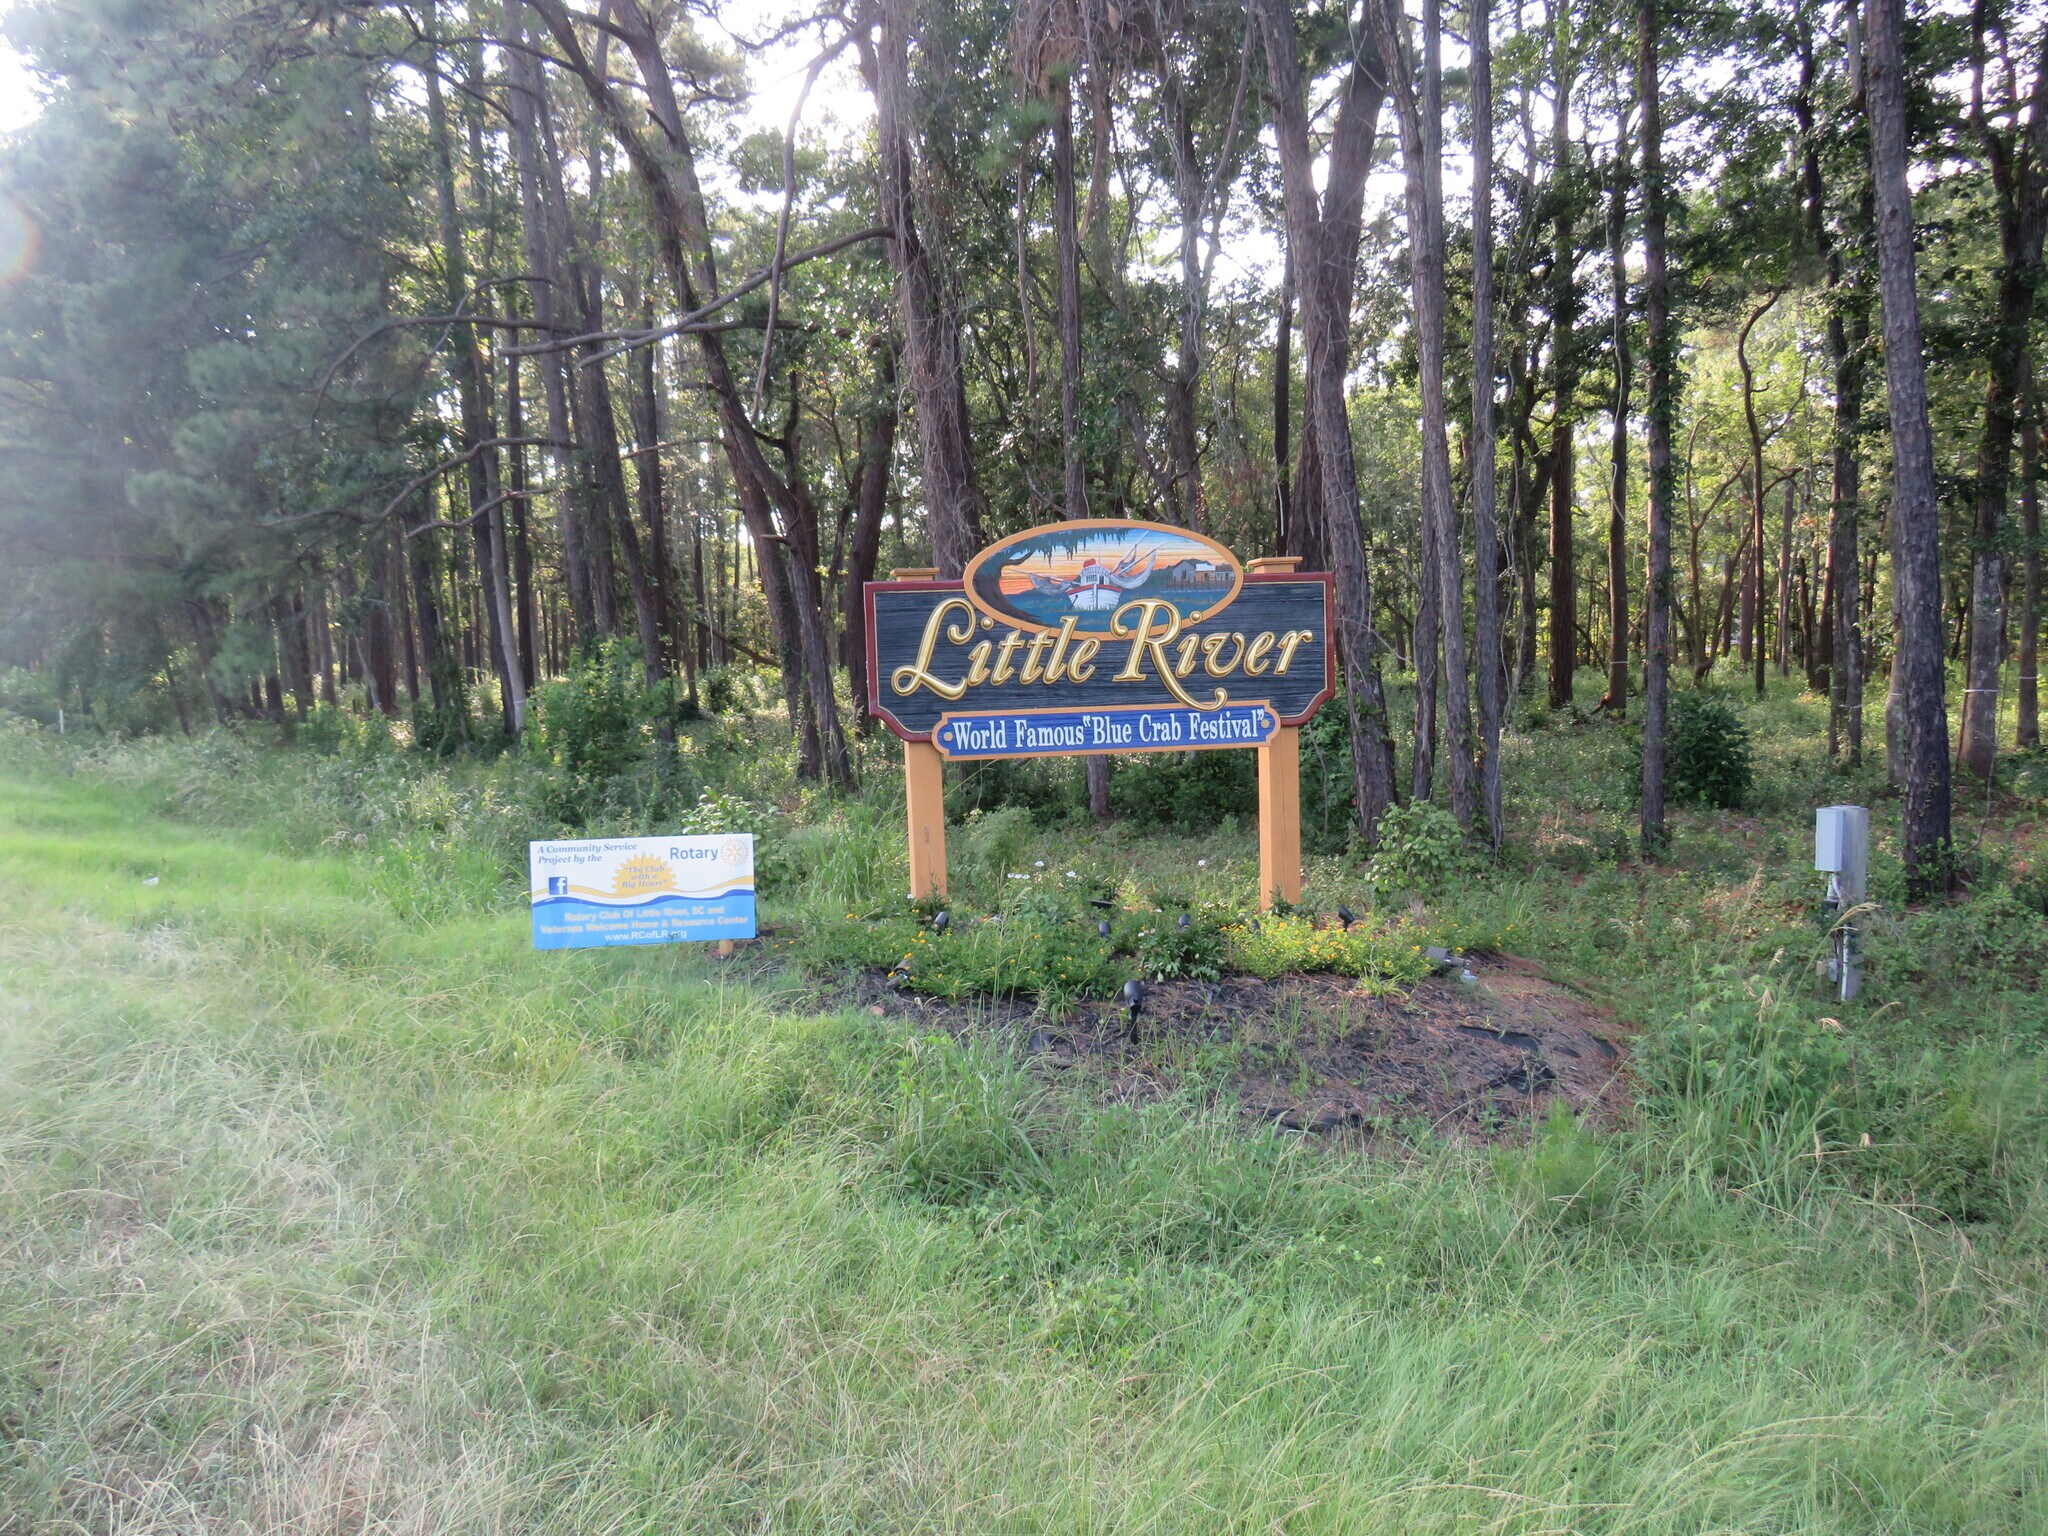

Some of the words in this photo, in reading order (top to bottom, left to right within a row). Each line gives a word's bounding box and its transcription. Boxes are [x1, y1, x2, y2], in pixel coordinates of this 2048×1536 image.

[891, 598, 1101, 701] Little
[1109, 598, 1314, 712] River
[952, 720, 1008, 751] World
[1014, 716, 1084, 748] Famous
[1139, 712, 1182, 742] Crab
[537, 846, 545, 854] A
[546, 844, 601, 853] Community
[603, 842, 638, 852] Service
[670, 847, 718, 861] Rotary
[538, 856, 571, 865] Project
[574, 854, 585, 864] by
[587, 854, 602, 862] the
[645, 865, 665, 873] Club
[622, 881, 636, 889] Big
[565, 912, 597, 923] Rotary
[600, 911, 620, 920] Club
[636, 908, 660, 918] Little
[692, 906, 704, 915] SC
[708, 905, 724, 915] and
[541, 924, 583, 934] Veterans
[586, 922, 629, 932] Welcome
[632, 920, 658, 929] Home
[662, 919, 669, 928] &
[718, 916, 749, 925] Center
